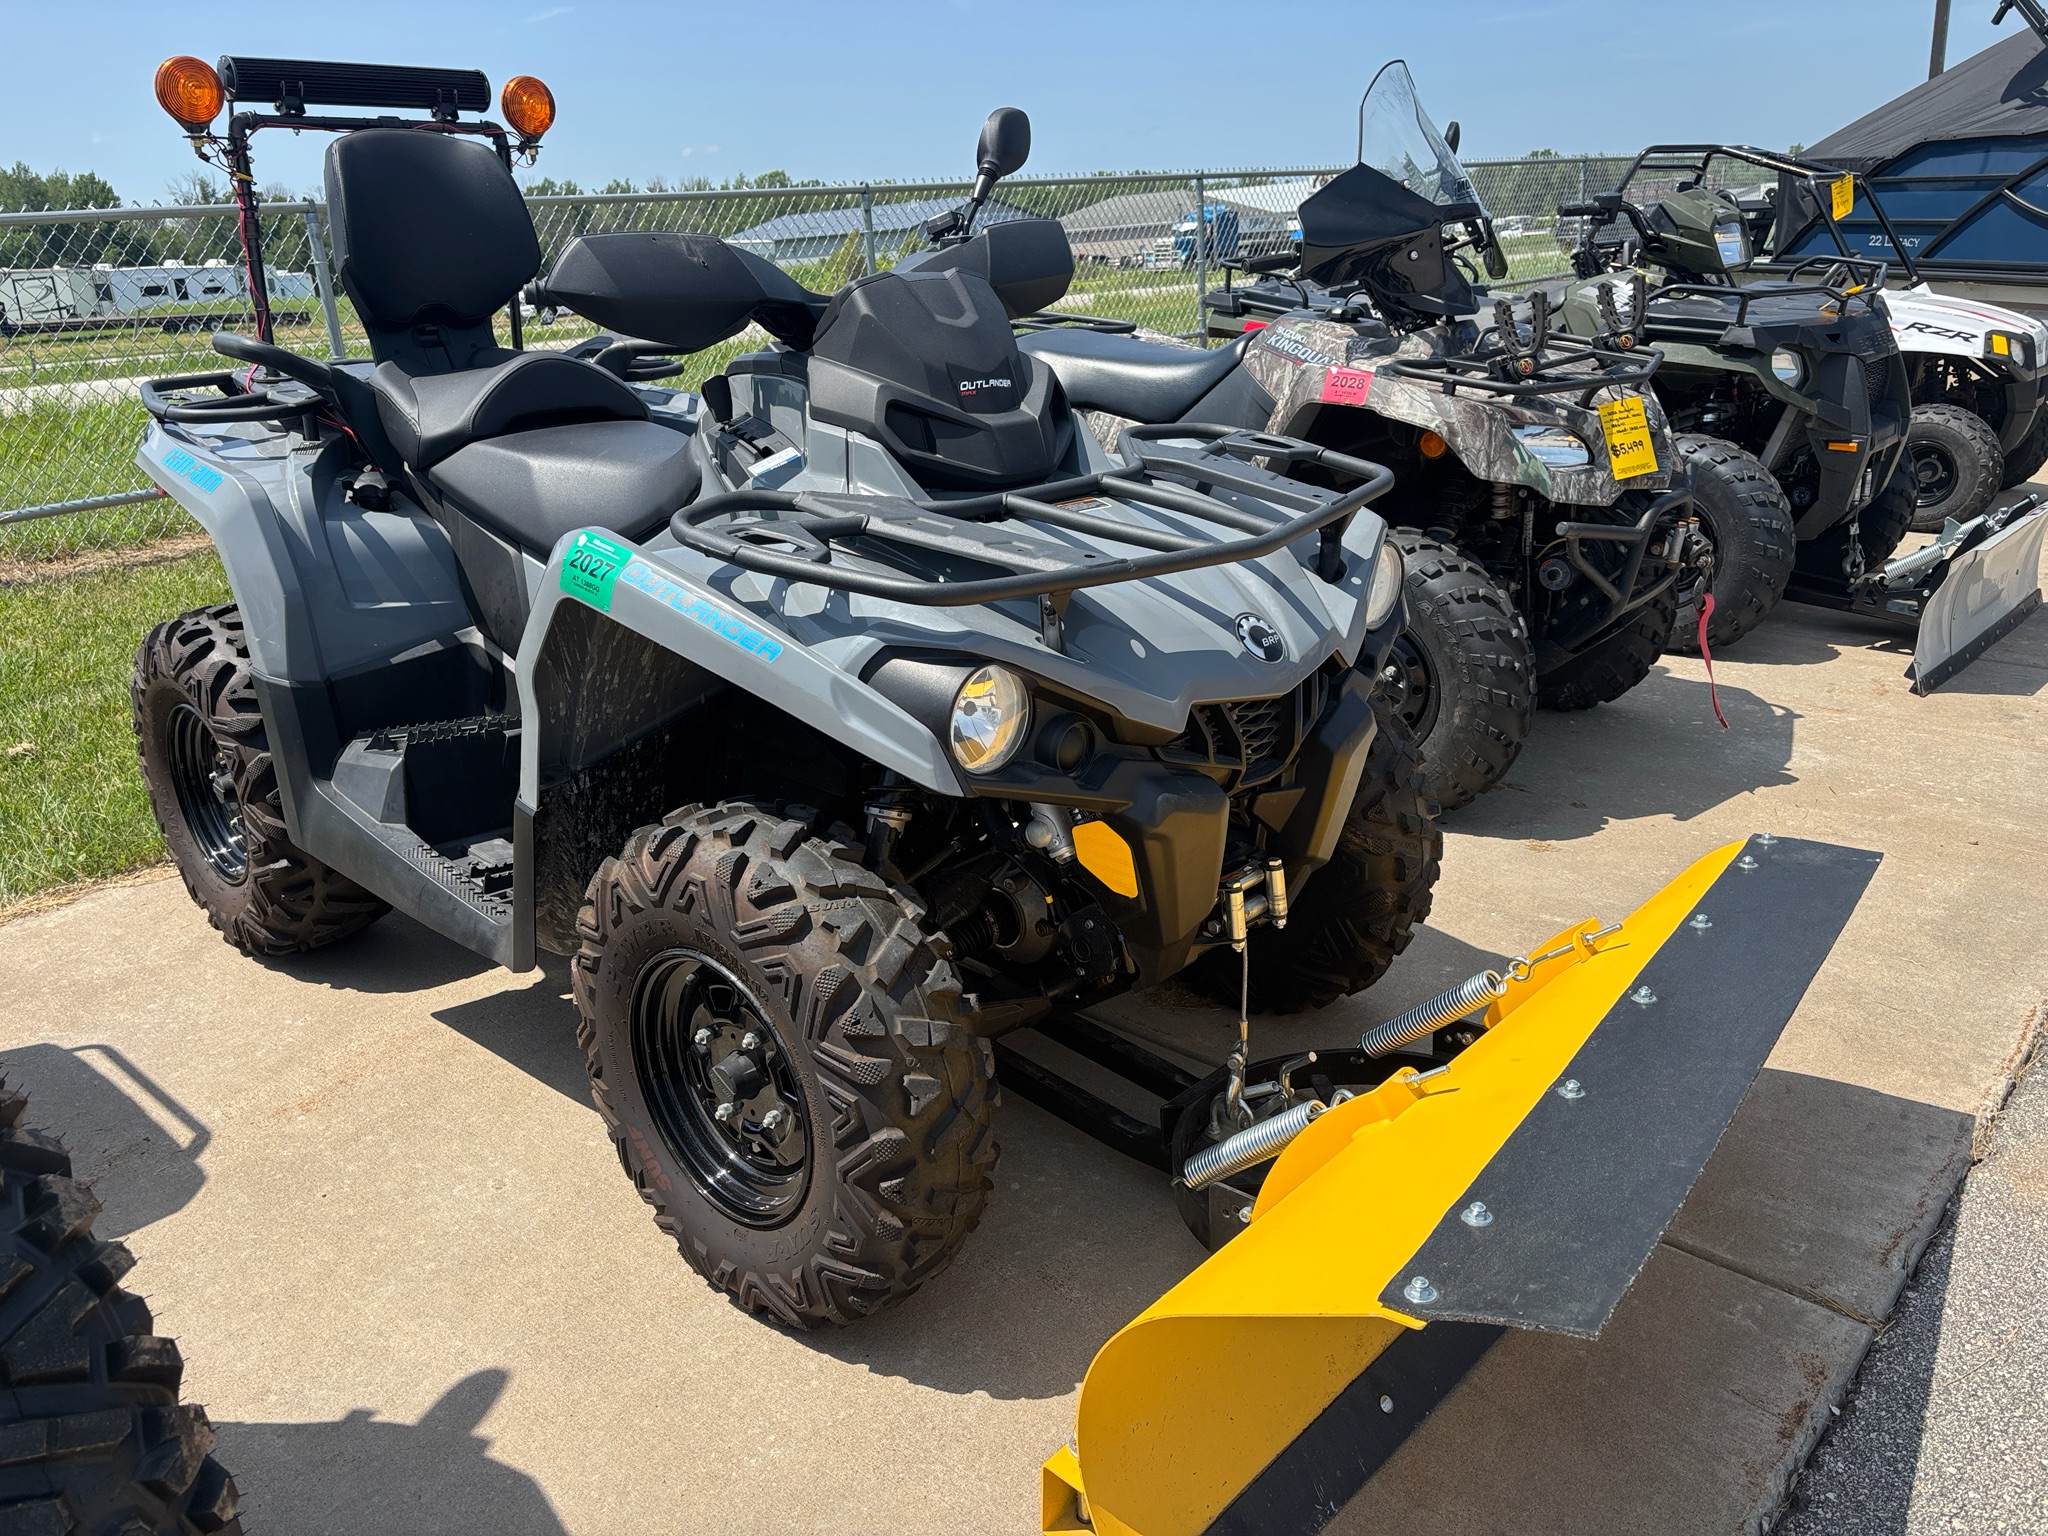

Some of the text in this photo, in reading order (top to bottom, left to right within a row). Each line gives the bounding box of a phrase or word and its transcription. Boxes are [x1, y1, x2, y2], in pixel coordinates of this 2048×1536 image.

[1869, 235, 1920, 247] 22 LACY
[1276, 326, 1307, 343] SUZUKI
[1901, 322, 1979, 343] RZR
[960, 379, 1011, 391] OUTLANDER
[1331, 376, 1365, 389] 2028
[1611, 440, 1645, 458] $5,499
[162, 448, 224, 494] can-am
[569, 549, 615, 582] 2027
[620, 563, 783, 664] OUTLANDER
[1262, 635, 1279, 647] BRP
